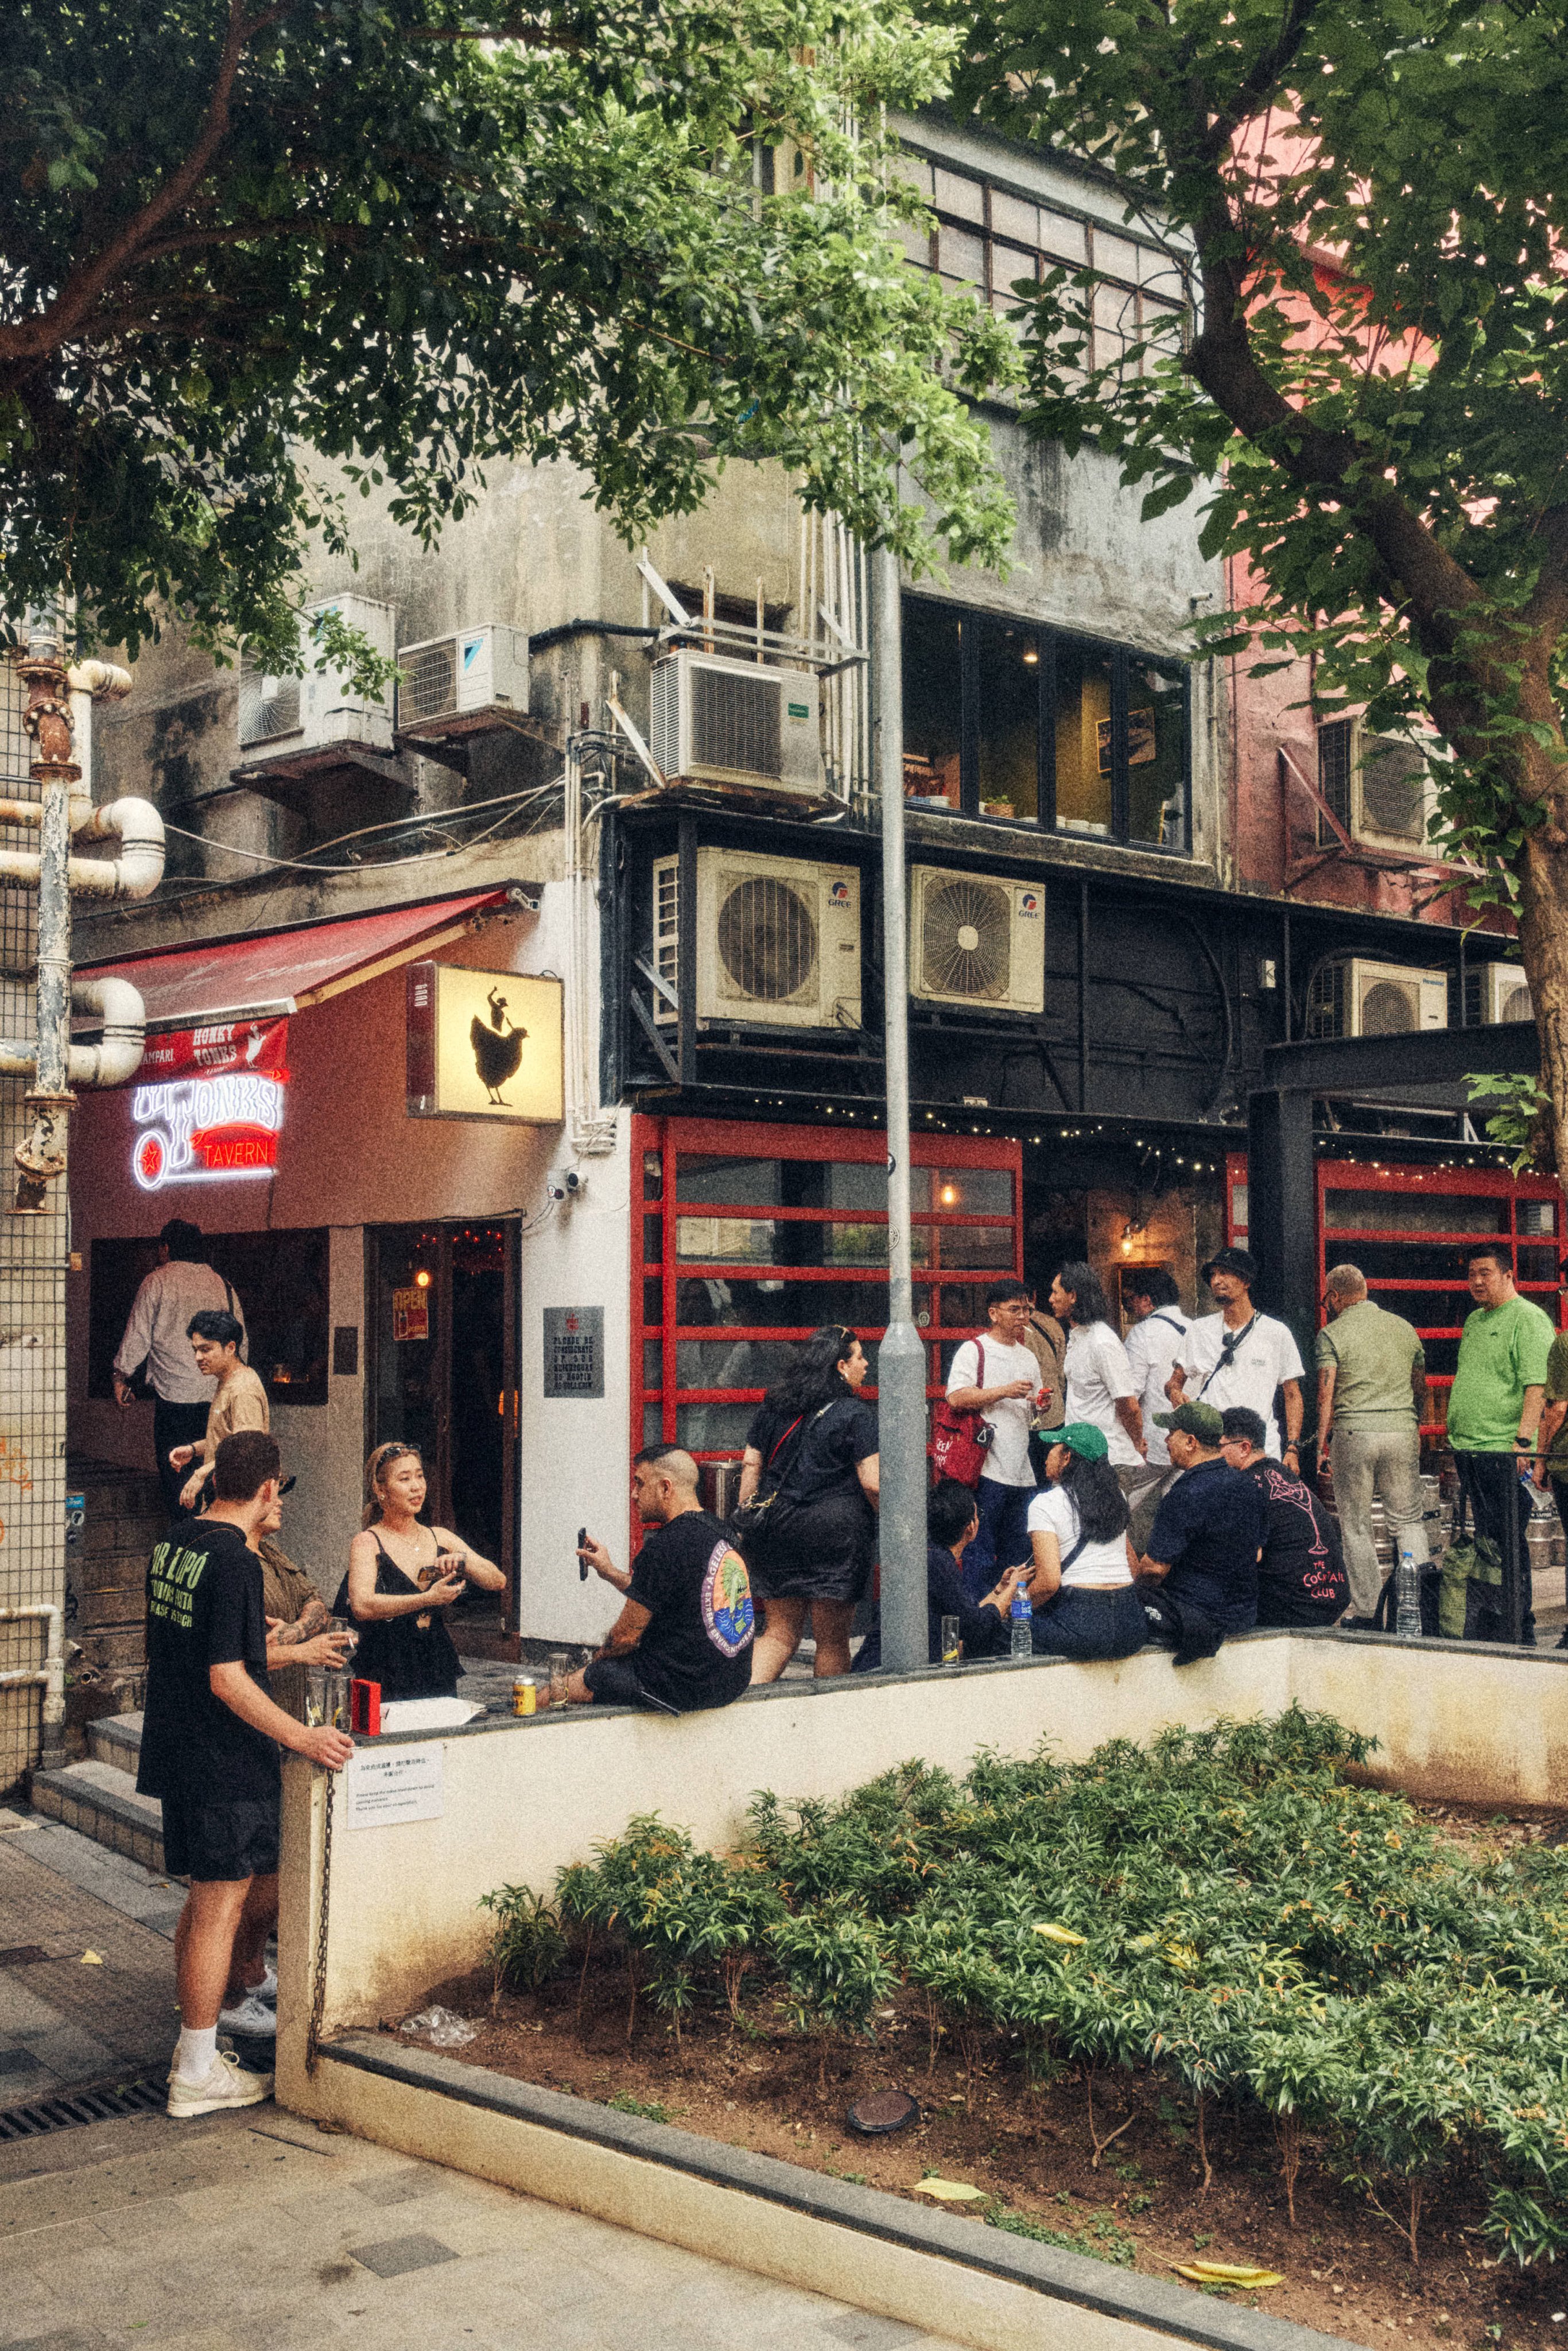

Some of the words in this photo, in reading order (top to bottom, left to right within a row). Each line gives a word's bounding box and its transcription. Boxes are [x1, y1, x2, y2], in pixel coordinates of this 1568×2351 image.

[828, 899, 852, 908] GREE
[1019, 910, 1041, 919] GREE
[193, 1025, 235, 1046] HONKY
[143, 1049, 174, 1064] AMPARI
[193, 1045, 237, 1066] TONKS
[204, 1141, 268, 1167] TAVERN
[394, 1290, 426, 1310] OPEN
[553, 1337, 580, 1345] PLEASE
[584, 1336, 593, 1344] BE
[706, 1542, 727, 1582] AGELESS
[1313, 1560, 1326, 1570] THE
[1303, 1572, 1345, 1587] COCKTAIL
[1311, 1586, 1336, 1599] CLUB
[705, 1592, 714, 1628] EXTREME
